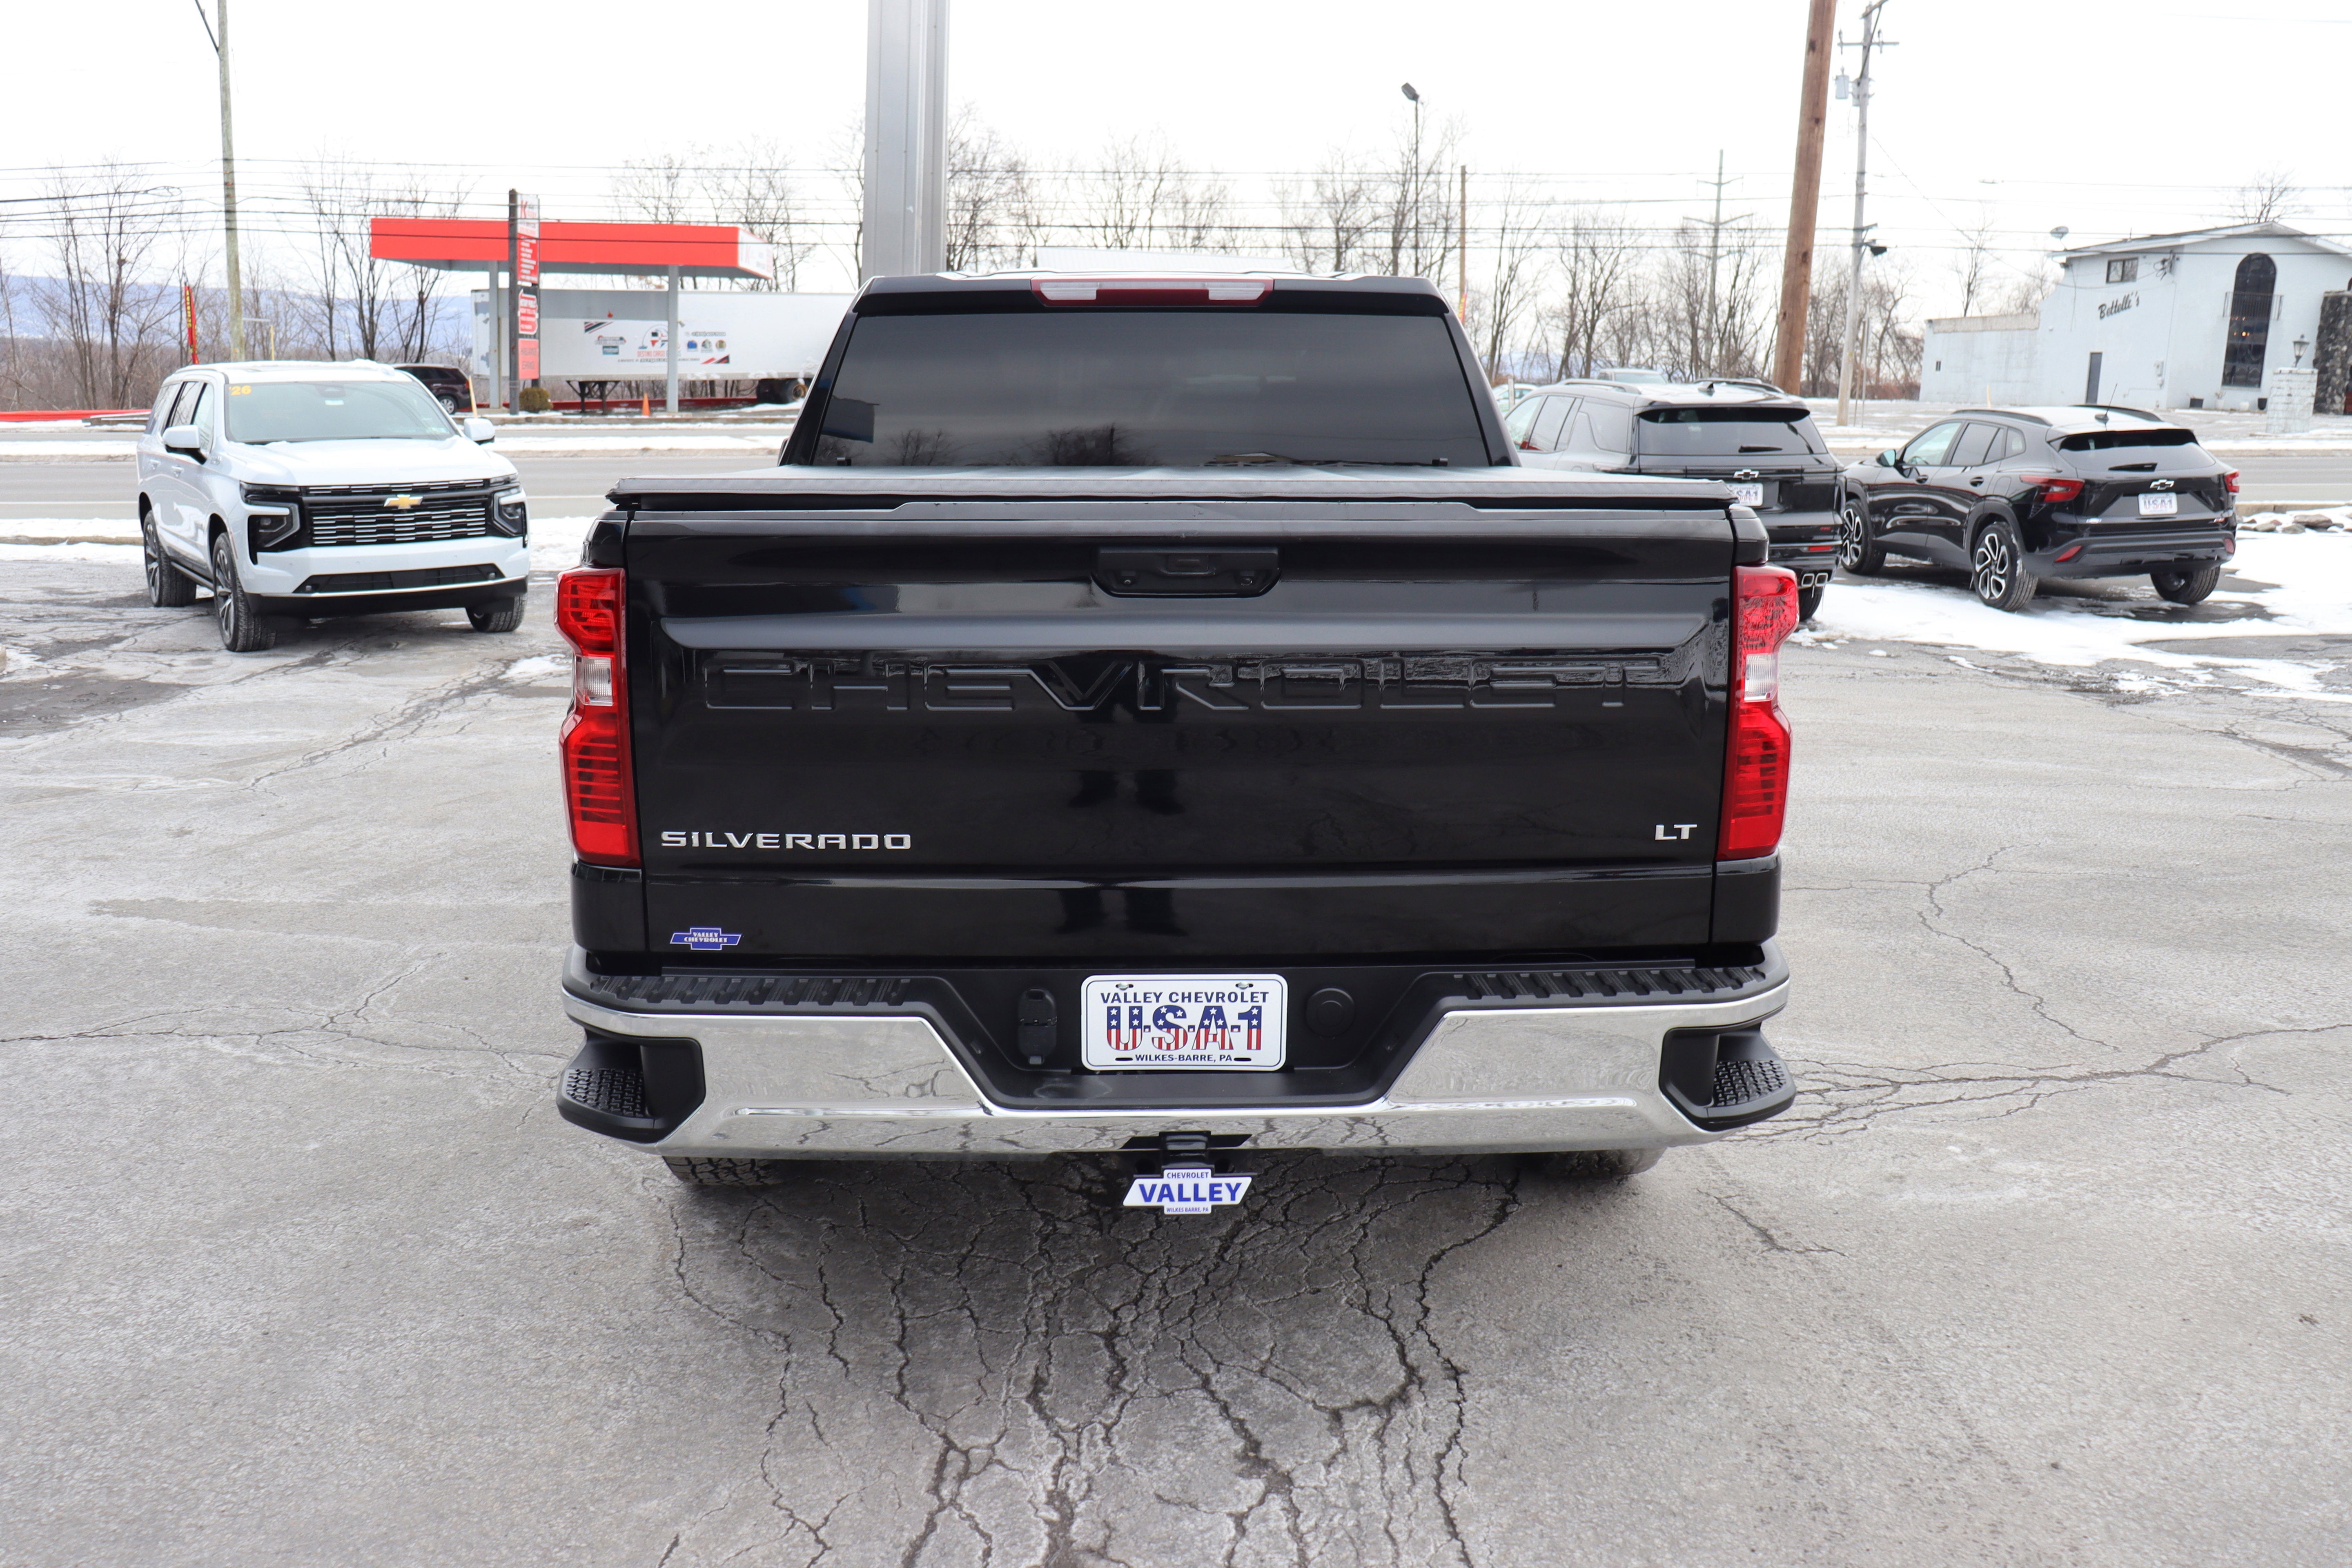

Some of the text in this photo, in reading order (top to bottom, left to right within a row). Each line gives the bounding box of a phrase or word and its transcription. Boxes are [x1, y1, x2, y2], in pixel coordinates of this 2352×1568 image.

[704, 657, 1659, 712] CHEVROLET
[661, 831, 911, 849] SILVERADO
[1655, 824, 1697, 840] LT
[1100, 991, 1269, 1004] VALLEY CHEVROLET
[1135, 1054, 1216, 1063] WILKES-BARRE,
[1138, 1183, 1243, 1203] VALLEY
